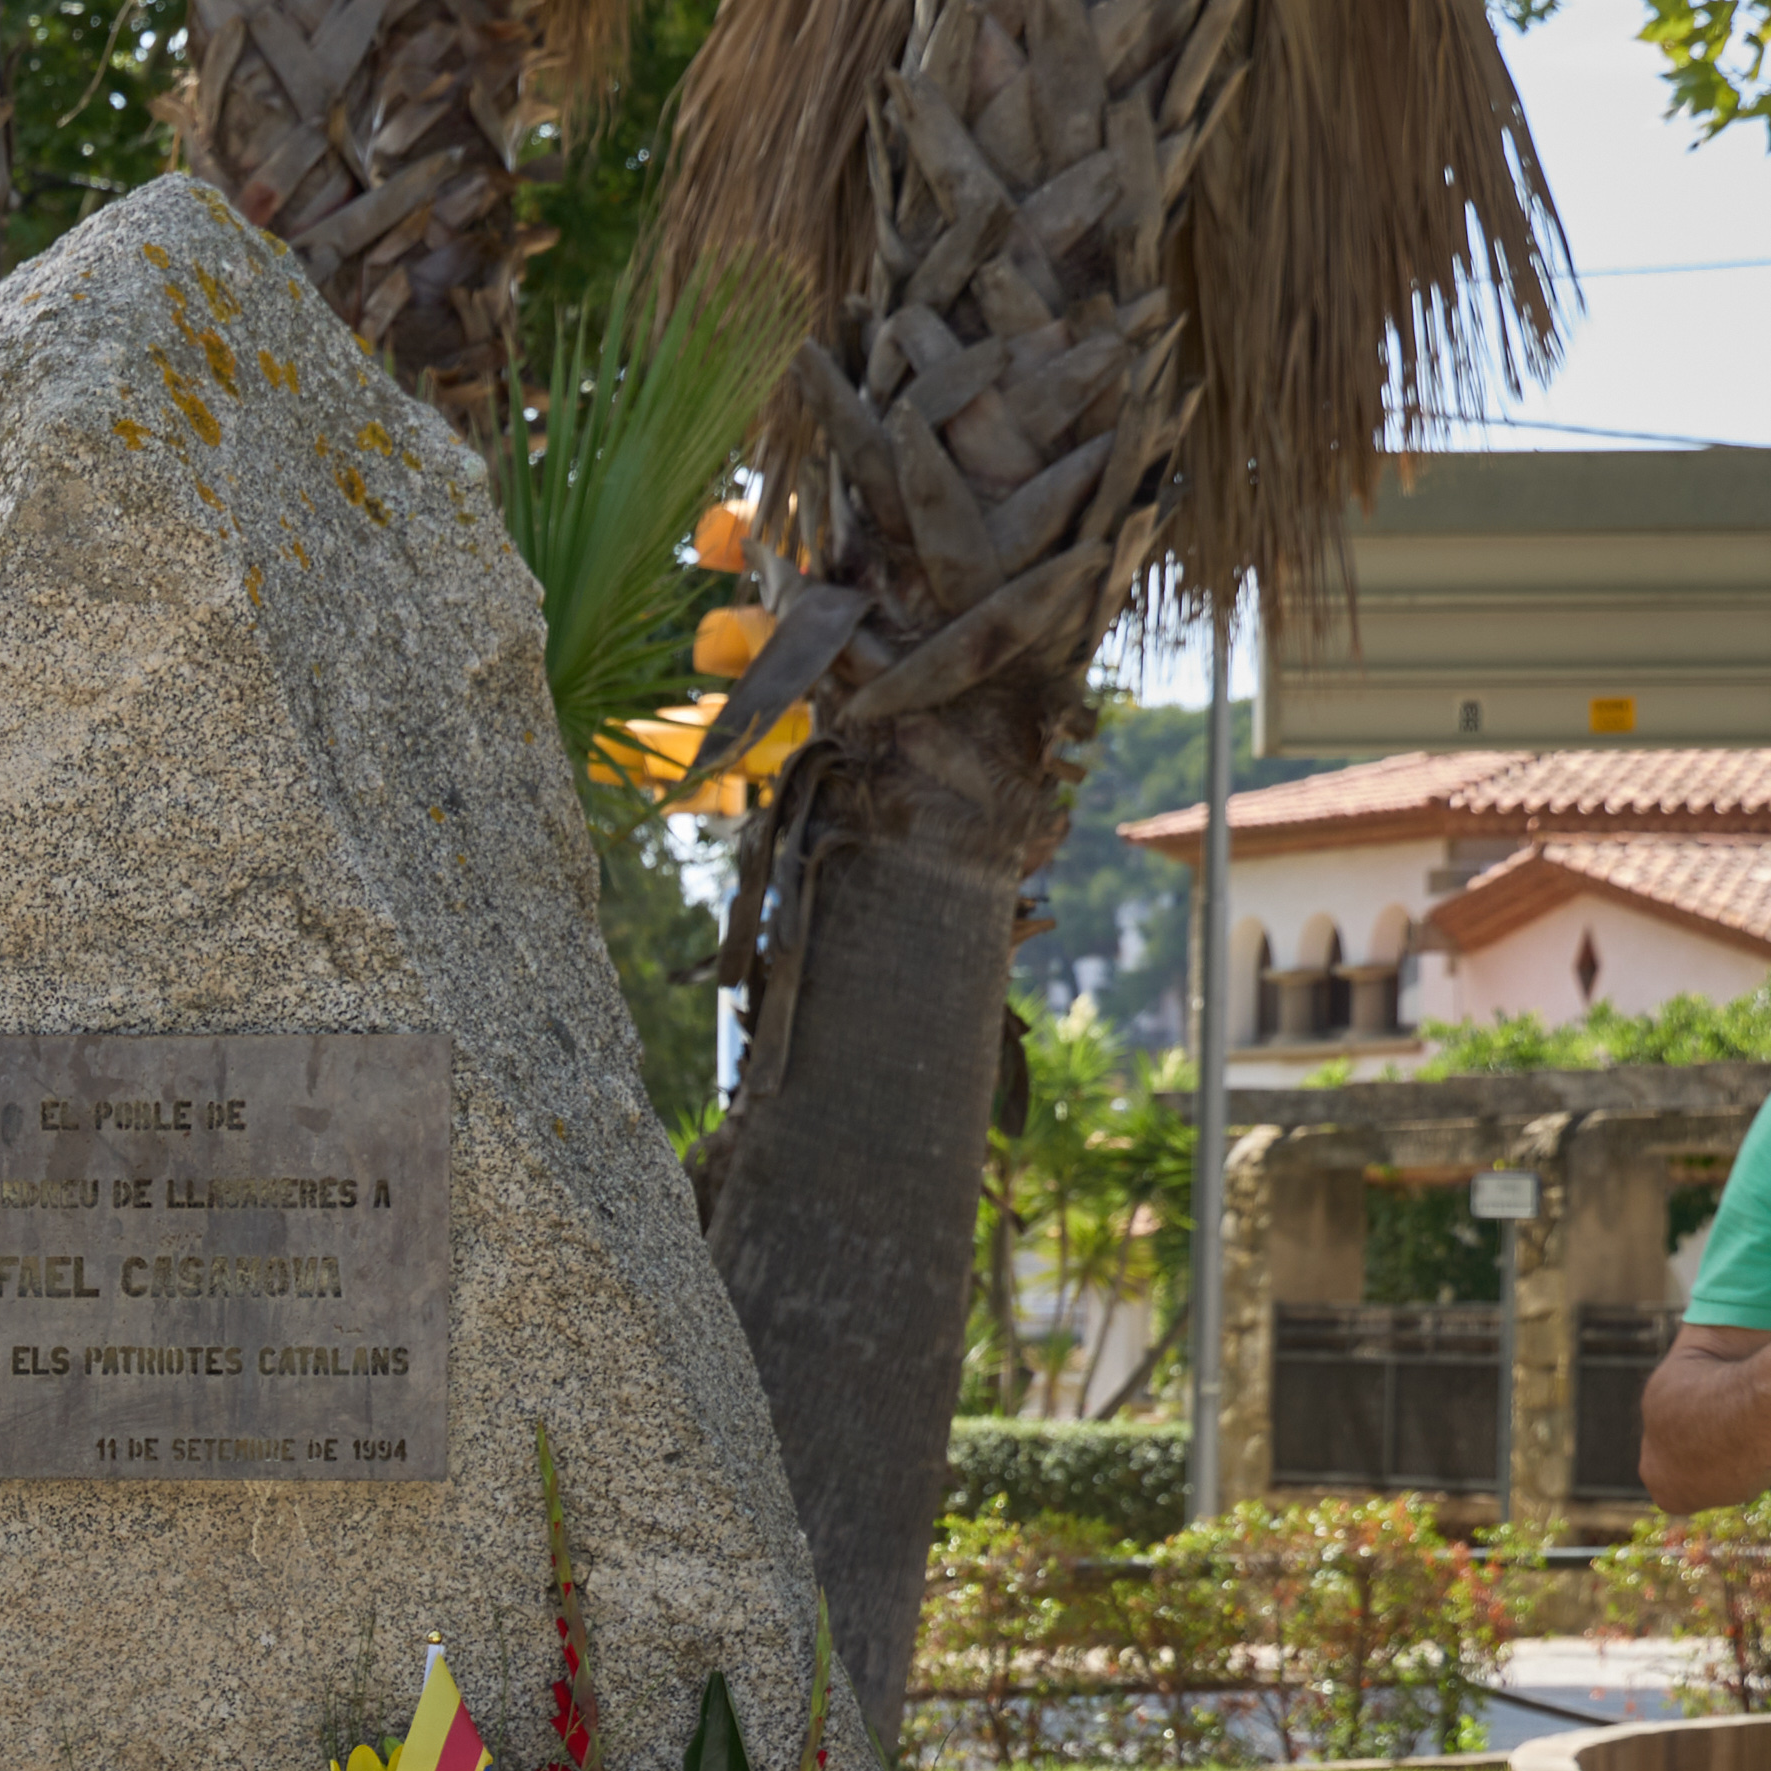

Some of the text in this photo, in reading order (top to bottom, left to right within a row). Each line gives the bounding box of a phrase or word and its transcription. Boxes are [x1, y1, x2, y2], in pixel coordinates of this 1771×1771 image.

[40, 1099, 247, 1131] EL POBLE DE
[111, 1178, 154, 1210] DE
[372, 1178, 392, 1210] A
[119, 1255, 343, 1299] CASANOVA
[11, 1346, 71, 1376] ELS
[83, 1346, 244, 1376] PATRIOTES
[258, 1346, 410, 1376] CATALANS
[95, 1438, 408, 1462] 11 DE SETEMBRE DE 1994
